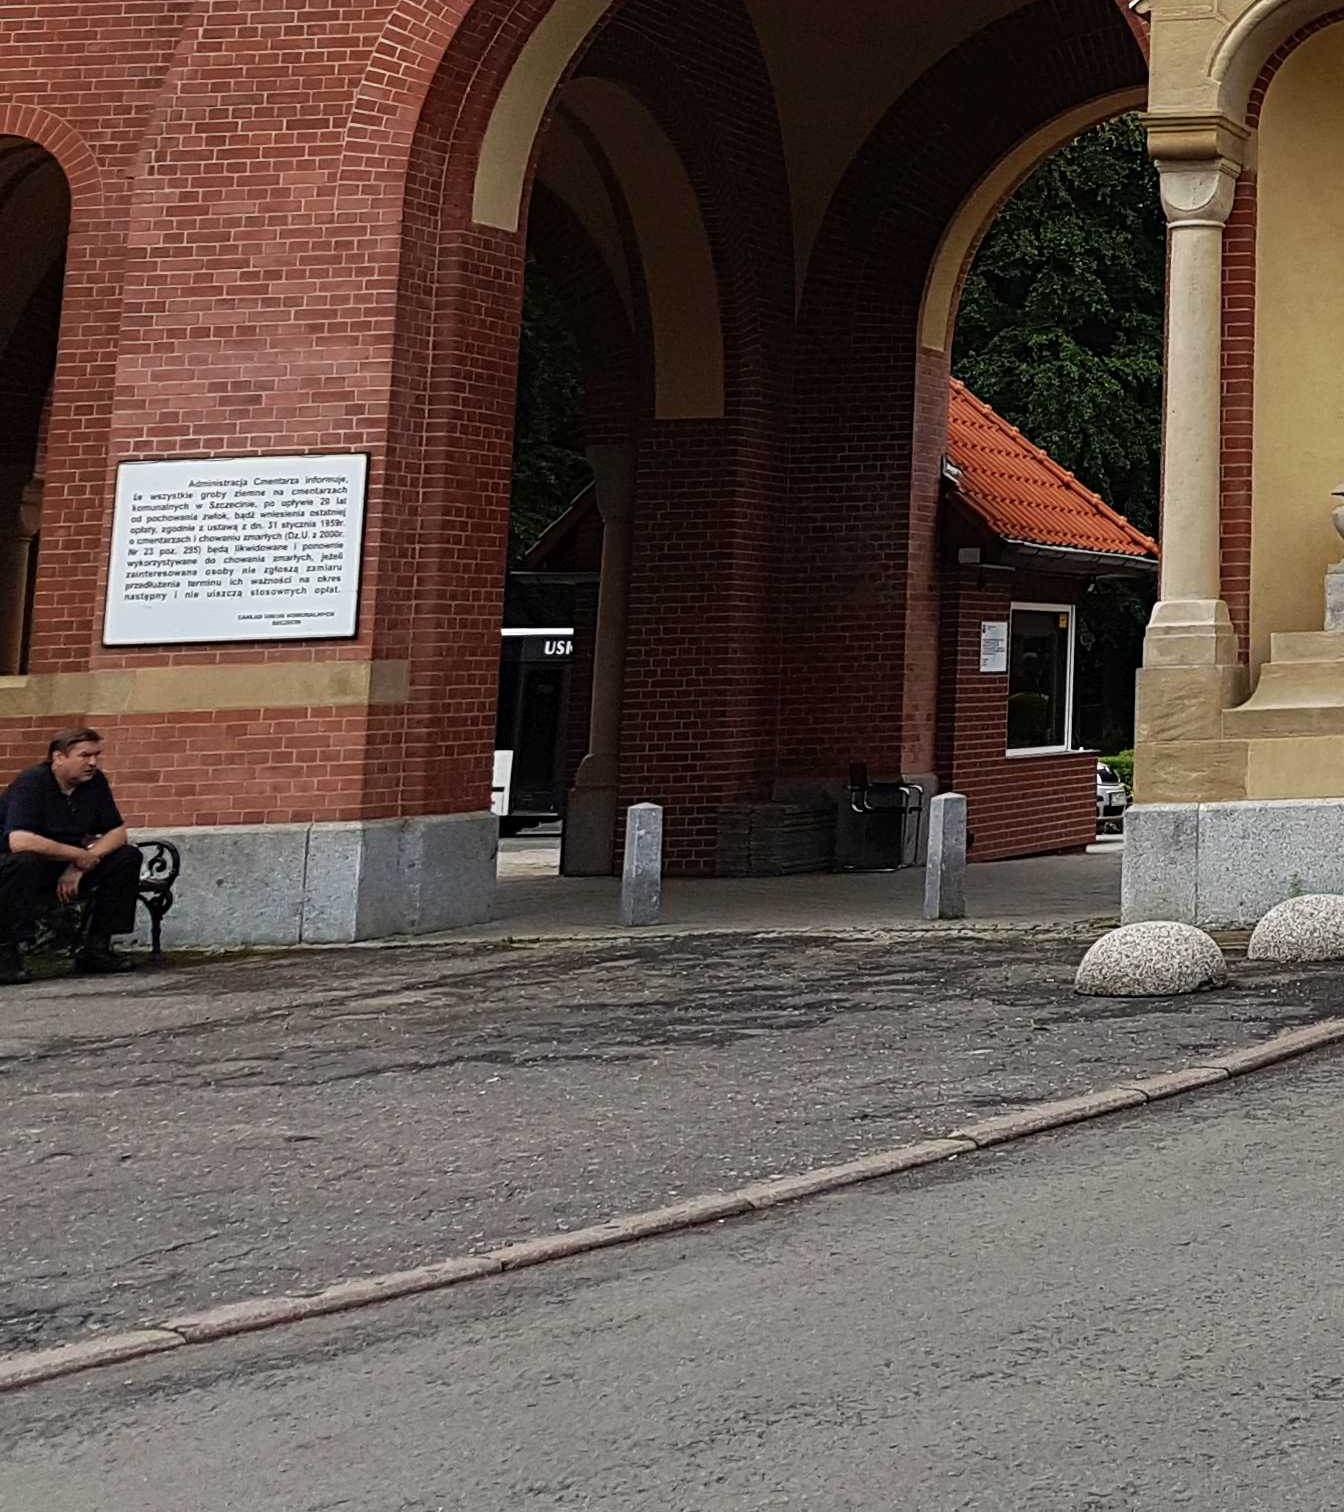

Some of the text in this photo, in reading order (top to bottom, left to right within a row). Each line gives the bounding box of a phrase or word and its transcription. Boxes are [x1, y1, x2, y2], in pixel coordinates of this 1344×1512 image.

[188, 478, 248, 488] Administracja
[253, 477, 300, 486] Cmentarza
[150, 492, 193, 501] wszystkie
[200, 491, 227, 501] groby
[291, 486, 348, 496] cmentarzach
[132, 502, 189, 512] komunalnych
[264, 500, 275, 509] po
[320, 497, 330, 506] 20
[336, 497, 347, 505] lat
[130, 515, 142, 523] od
[161, 524, 195, 534] zgodnie
[281, 521, 317, 530] stycznia
[136, 536, 191, 545] cmentarzach
[199, 534, 241, 543] chowaniu
[234, 544, 288, 553] likwidowane
[302, 543, 344, 551] ponownie
[127, 558, 197, 568] wykorzystywane
[223, 555, 265, 564] chowania
[205, 567, 234, 576] osoby
[242, 566, 256, 574] nie
[306, 564, 342, 572] zamiaru
[187, 579, 222, 587] terminu
[229, 578, 243, 586] ich
[317, 575, 341, 583] okres
[184, 590, 199, 599] nie
